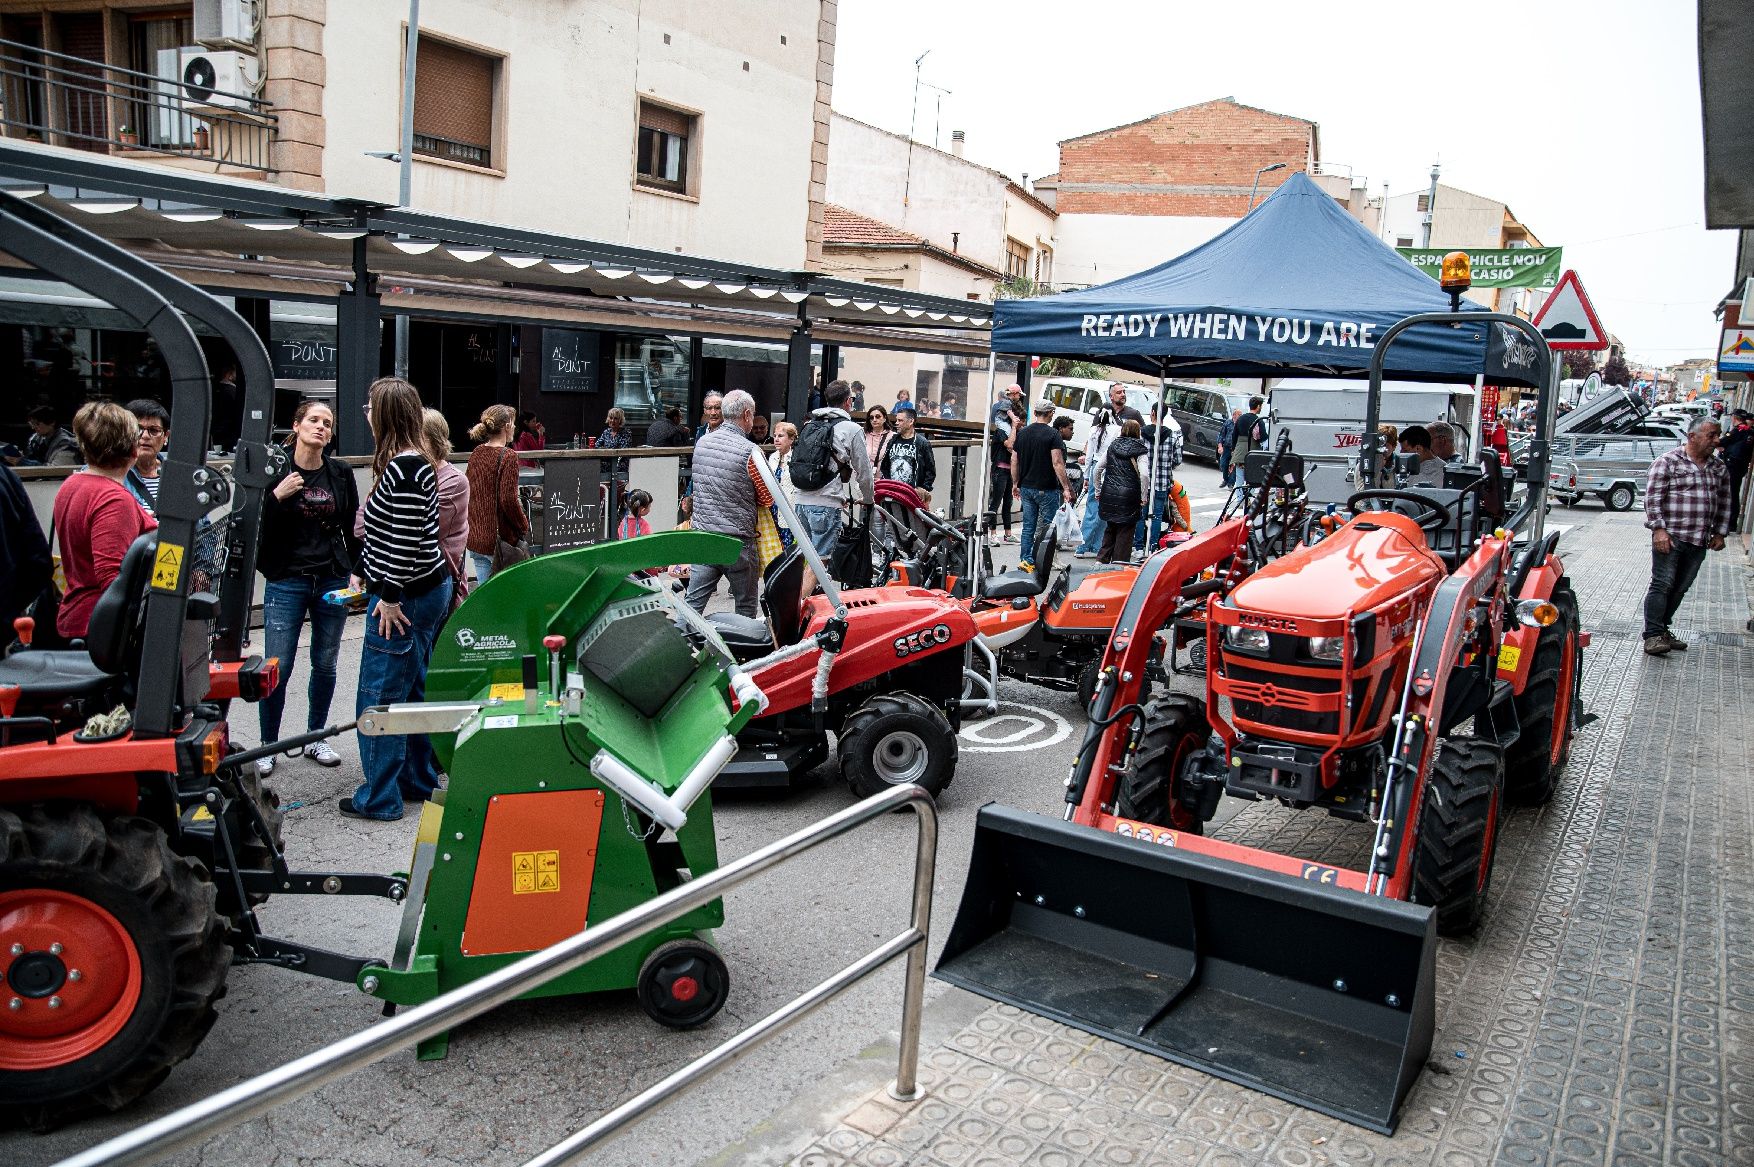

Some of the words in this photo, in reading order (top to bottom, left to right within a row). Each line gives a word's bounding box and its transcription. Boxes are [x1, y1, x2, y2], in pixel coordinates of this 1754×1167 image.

[1410, 254, 1443, 266] ESPA
[1469, 254, 1511, 266] HICLE
[1512, 254, 1547, 266] NOU
[1080, 313, 1163, 338] READY
[1168, 313, 1247, 341] WHEN
[1254, 315, 1312, 345] YOU
[1317, 321, 1377, 349] ARE
[552, 346, 566, 359] AL
[550, 491, 565, 505] AL
[549, 503, 596, 521] PUNT
[1238, 613, 1299, 632] KUBOTA
[893, 623, 952, 657] SECO
